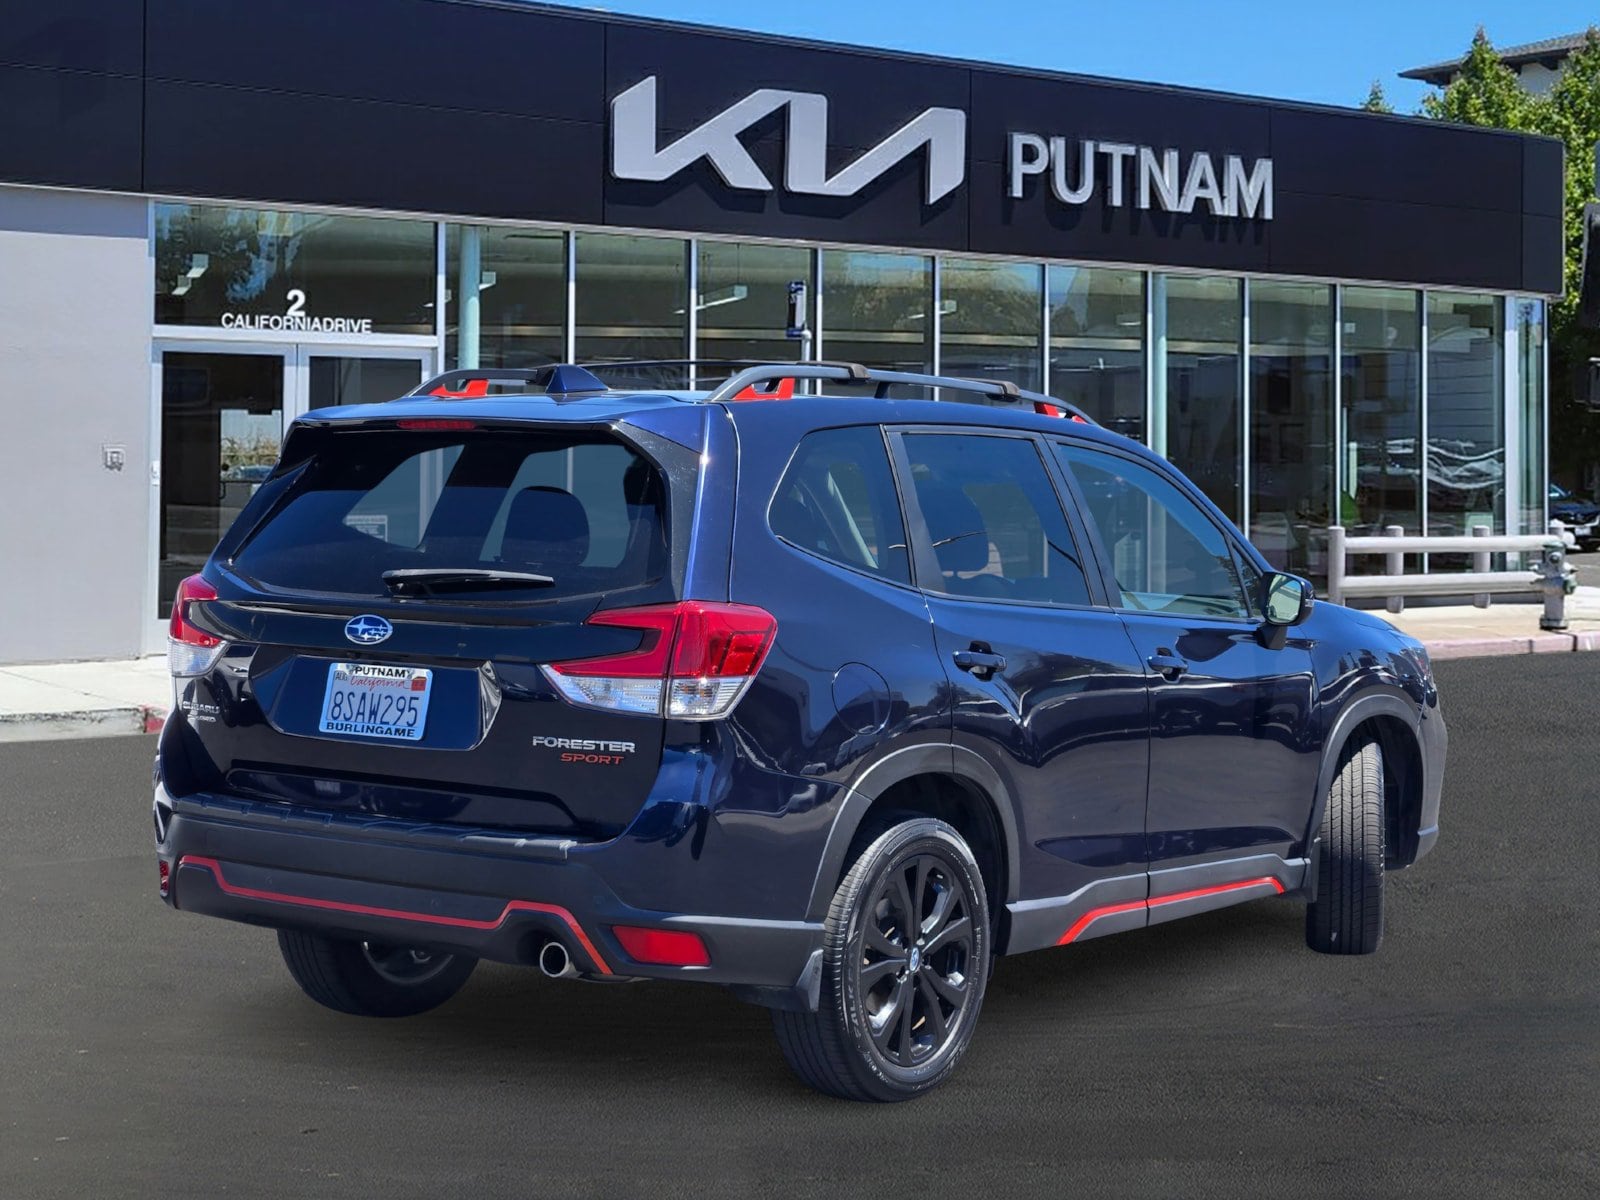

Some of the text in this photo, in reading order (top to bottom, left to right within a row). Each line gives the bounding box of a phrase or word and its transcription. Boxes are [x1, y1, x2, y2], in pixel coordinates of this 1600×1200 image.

[1009, 132, 1274, 221] PUTNAM
[286, 289, 306, 317] 2
[355, 665, 406, 678] PUTNAM
[331, 690, 419, 728] 8SAW295
[326, 721, 416, 738] BURLINGAME
[532, 736, 636, 753] FORESTER
[560, 752, 625, 765] SPORT
